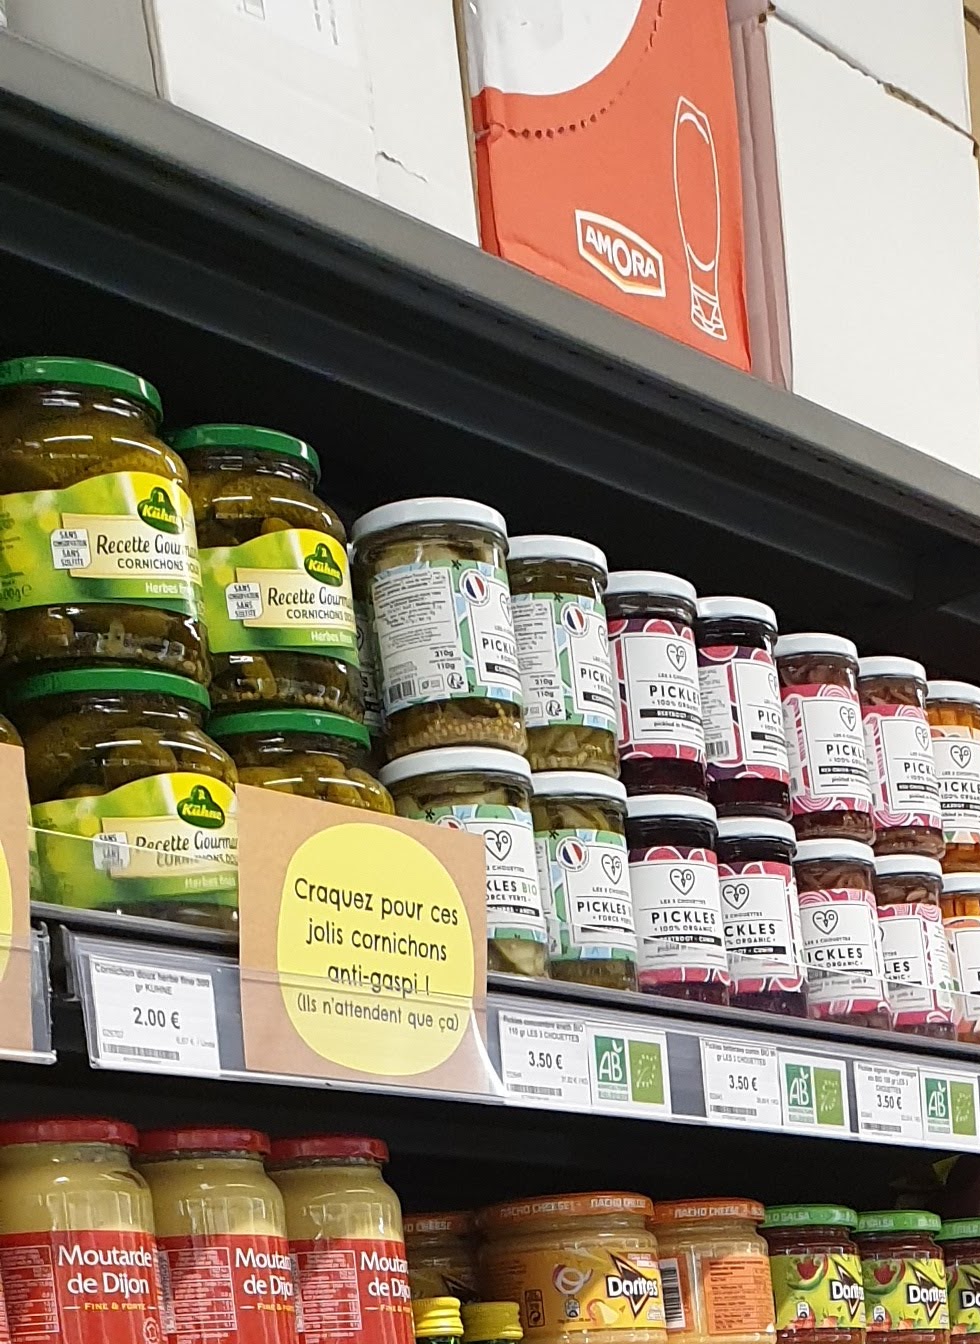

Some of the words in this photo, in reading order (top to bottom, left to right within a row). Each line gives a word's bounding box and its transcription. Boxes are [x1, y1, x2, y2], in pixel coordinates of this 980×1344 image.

[585, 226, 657, 279] AMORA
[97, 533, 150, 555] Recette
[117, 557, 184, 572] CORNICHONS
[267, 587, 315, 606] Recette
[295, 877, 373, 911] Craquez
[381, 896, 423, 920] pour
[431, 904, 458, 926] ces
[651, 910, 716, 925] PICKLES
[306, 918, 343, 945] jolis
[351, 930, 447, 962] cornichons
[328, 964, 418, 998] anti-gaspi
[133, 1007, 165, 1028] 2.00
[171, 1013, 181, 1030] €
[297, 992, 317, 1012] (Ils
[323, 997, 402, 1024] n'attendent
[408, 1011, 433, 1030] que
[438, 1013, 460, 1033] ça)
[528, 1050, 553, 1069] 3.50
[729, 1074, 748, 1091] 3.50
[58, 1245, 153, 1267] Moutarde
[67, 1274, 98, 1294] de
[103, 1272, 149, 1297] Dijon
[607, 1277, 659, 1300] Doritos
[84, 1302, 109, 1312] FINE
